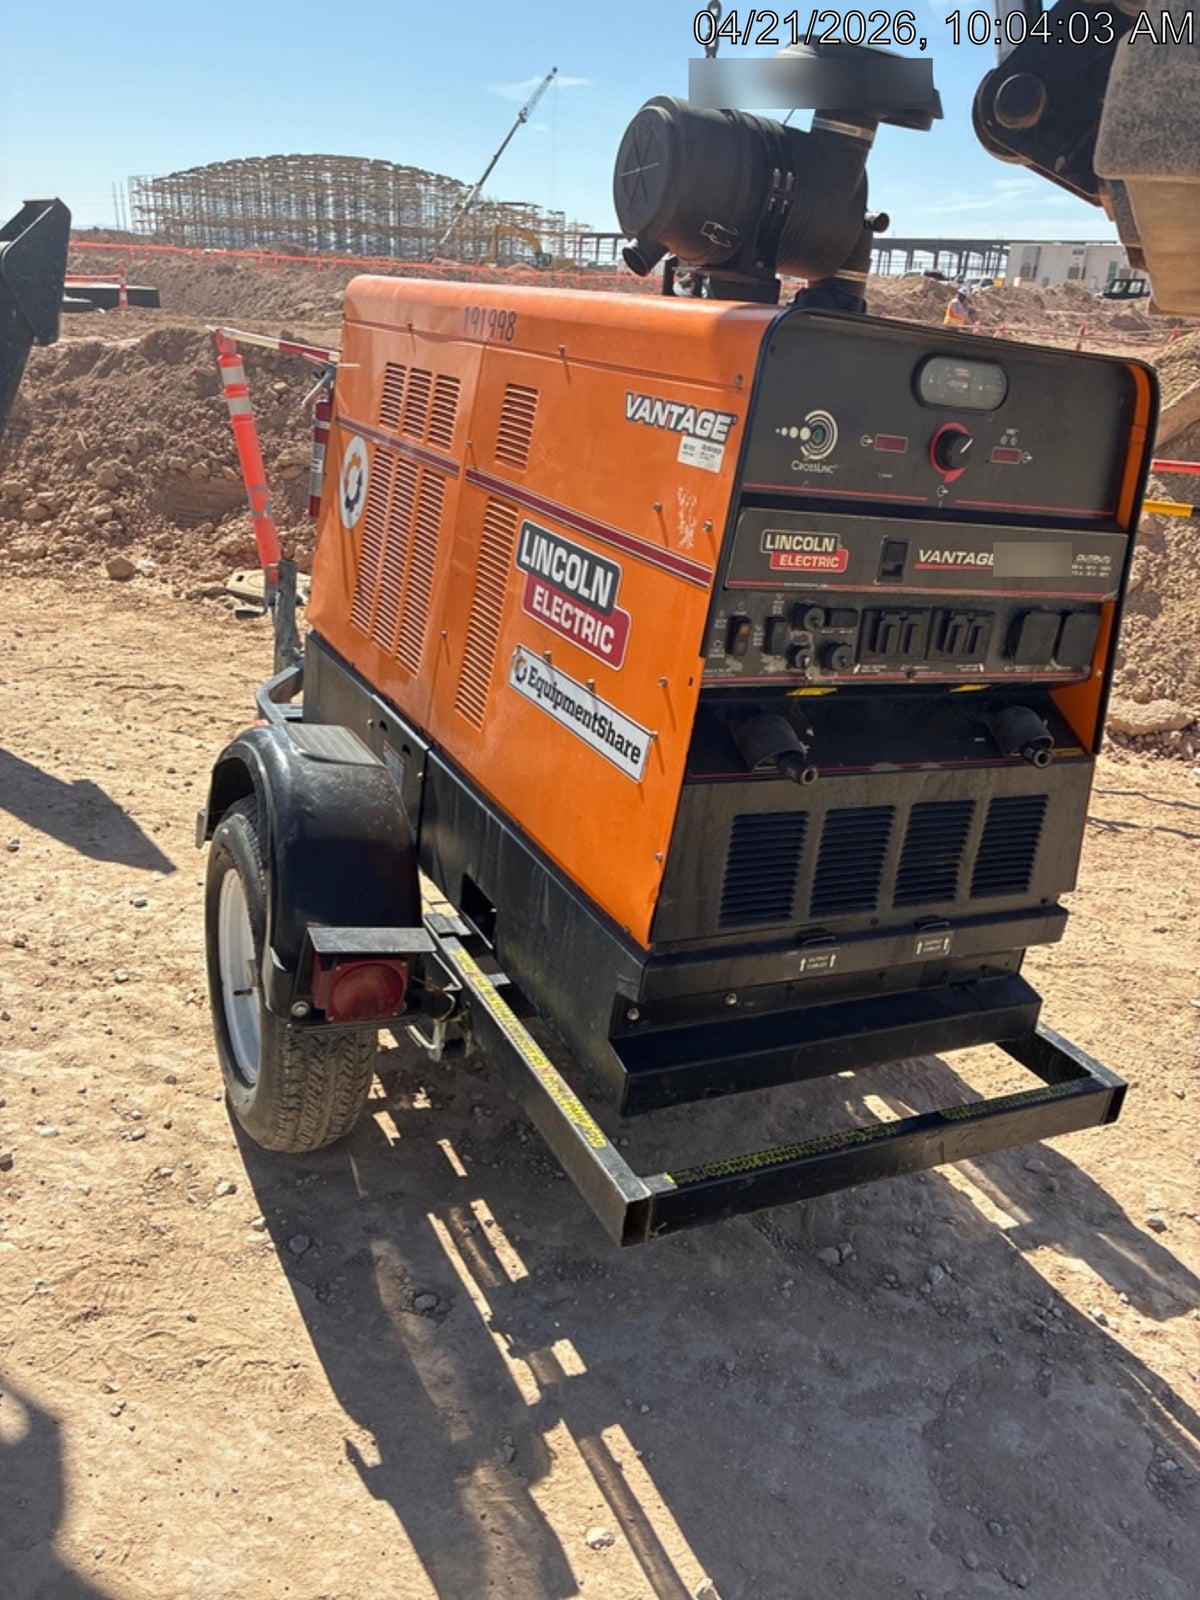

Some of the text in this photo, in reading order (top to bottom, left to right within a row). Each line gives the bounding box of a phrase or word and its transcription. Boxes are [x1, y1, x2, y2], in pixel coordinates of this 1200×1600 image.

[463, 306, 517, 342] 191998
[625, 392, 733, 443] VANTAGE
[765, 531, 835, 552] LINCOLN
[780, 553, 840, 568] ELECTRIC
[520, 529, 614, 608] LINCOLN
[532, 584, 616, 655] ELECTRIC
[527, 666, 642, 765] EquipmentShare
